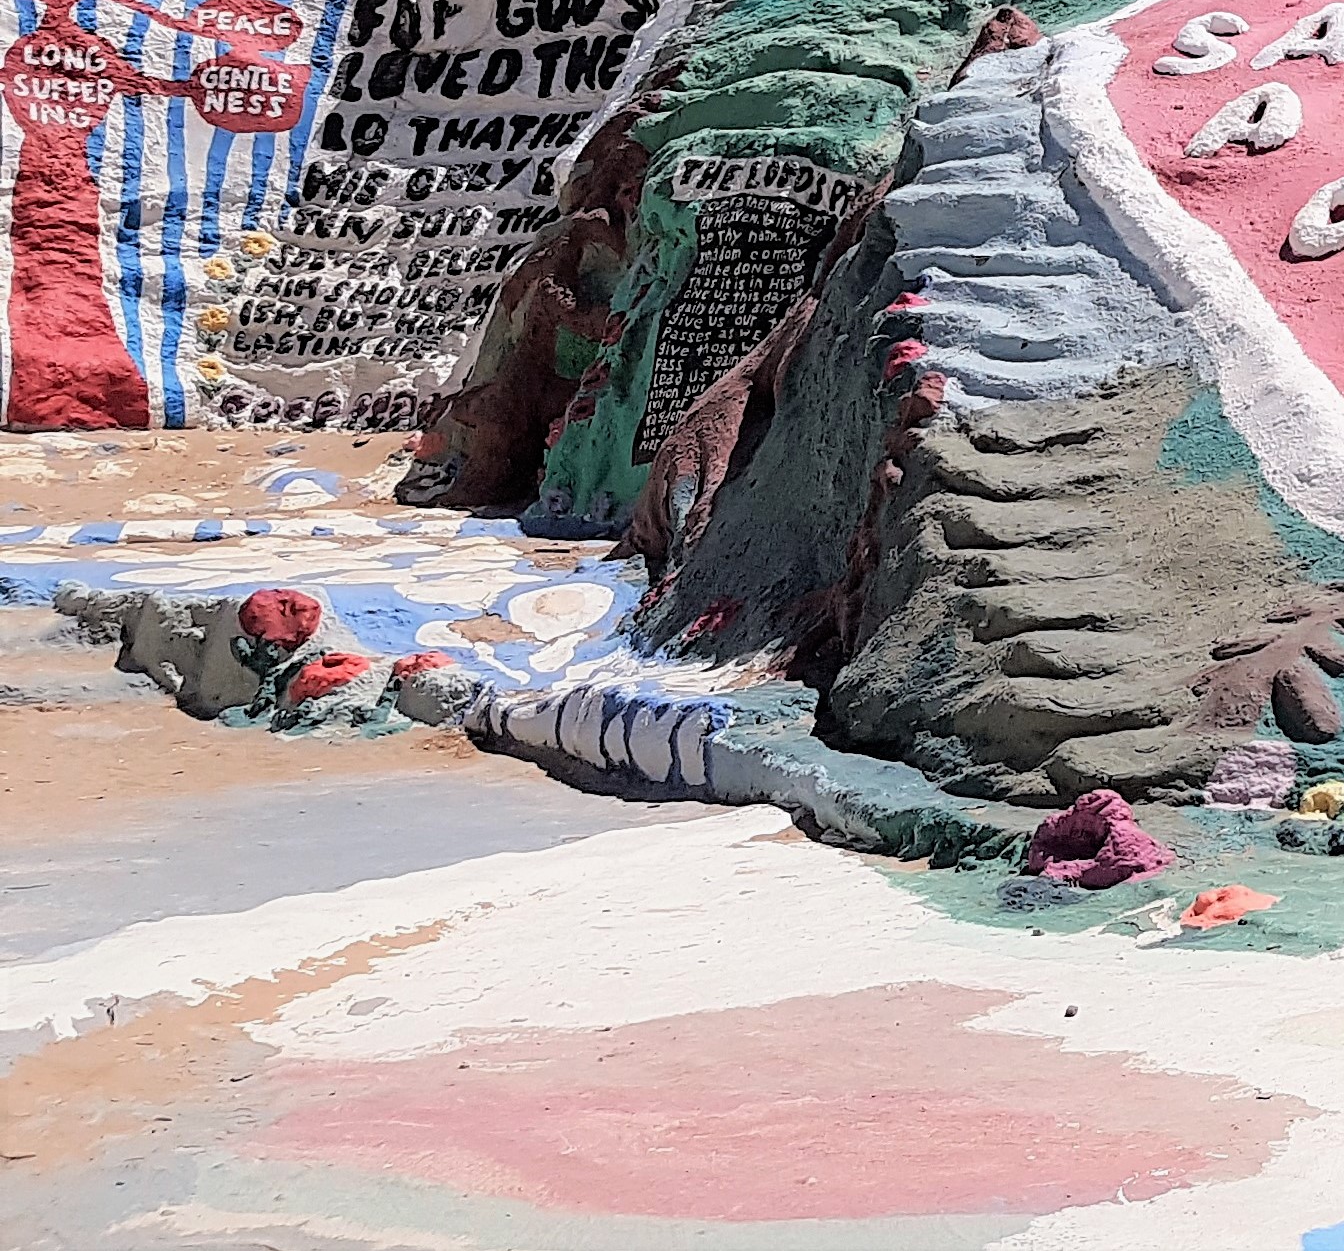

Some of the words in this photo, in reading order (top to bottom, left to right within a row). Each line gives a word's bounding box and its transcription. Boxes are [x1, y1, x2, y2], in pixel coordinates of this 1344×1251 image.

[197, 8, 293, 37] PEACE
[23, 44, 107, 74] LONG
[328, 49, 523, 103] LOVED
[533, 34, 634, 98] THE
[12, 73, 115, 105] SUFFER
[201, 64, 293, 95] GENTLE
[28, 102, 90, 128] ING
[204, 89, 286, 118] NESS
[1183, 80, 1304, 158] A
[302, 160, 391, 206] HIS
[254, 277, 323, 300] HIM
[313, 305, 390, 333] BUT
